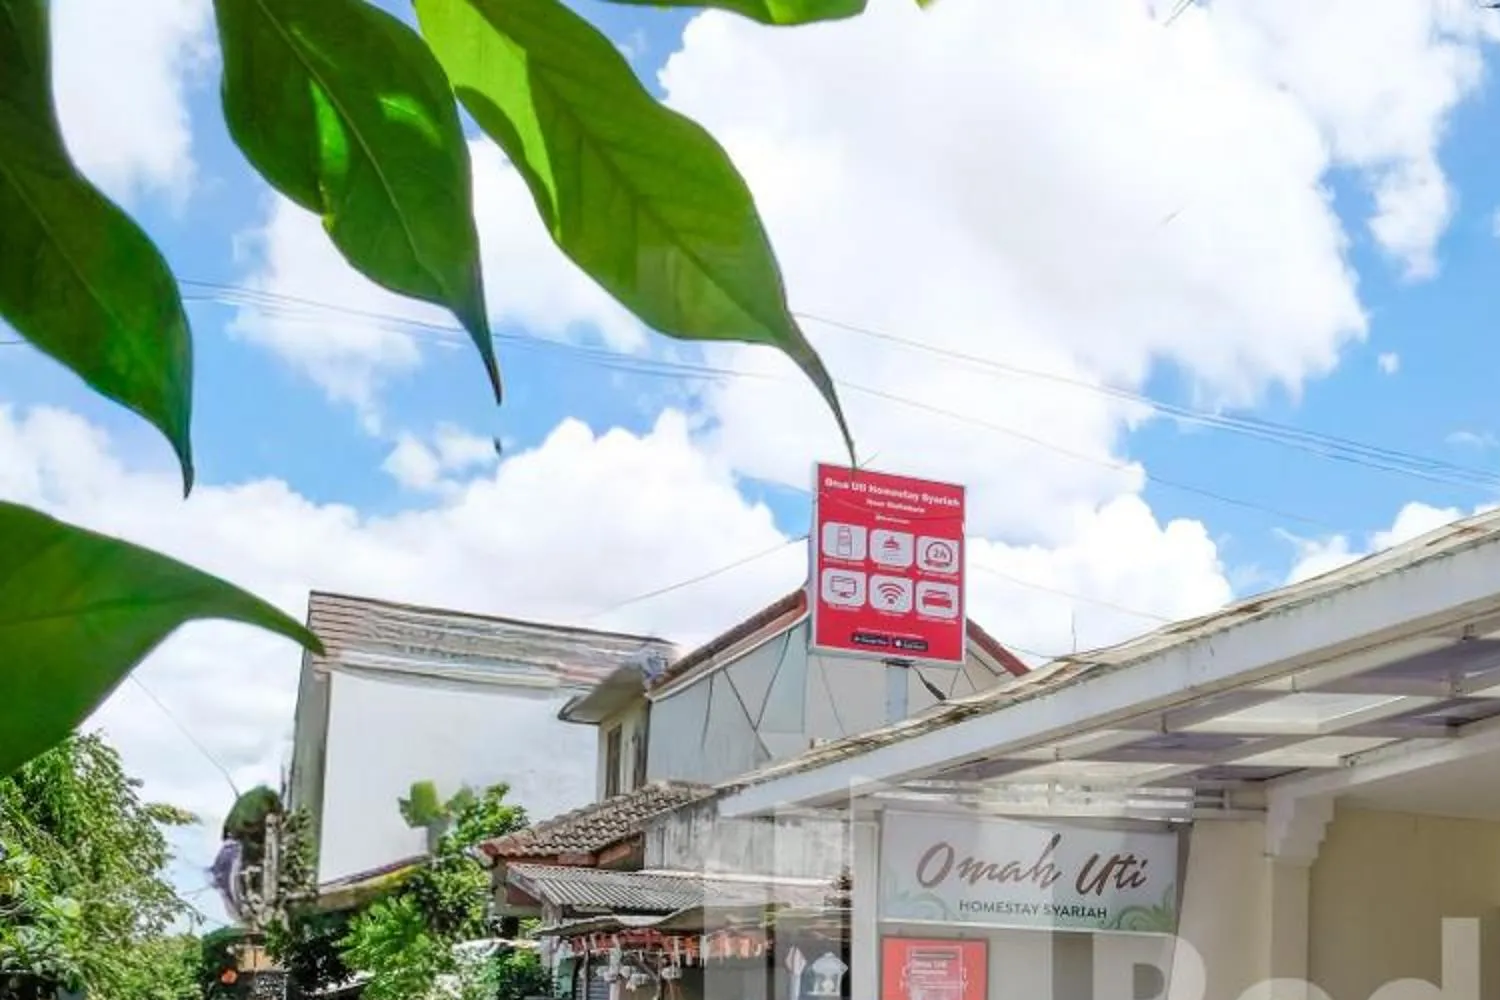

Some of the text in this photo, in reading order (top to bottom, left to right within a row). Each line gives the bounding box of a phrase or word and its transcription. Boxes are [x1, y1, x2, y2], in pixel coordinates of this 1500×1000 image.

[916, 833, 1149, 896] Omah Uti
[959, 899, 1107, 919] HOMESTAY SYARIAH
